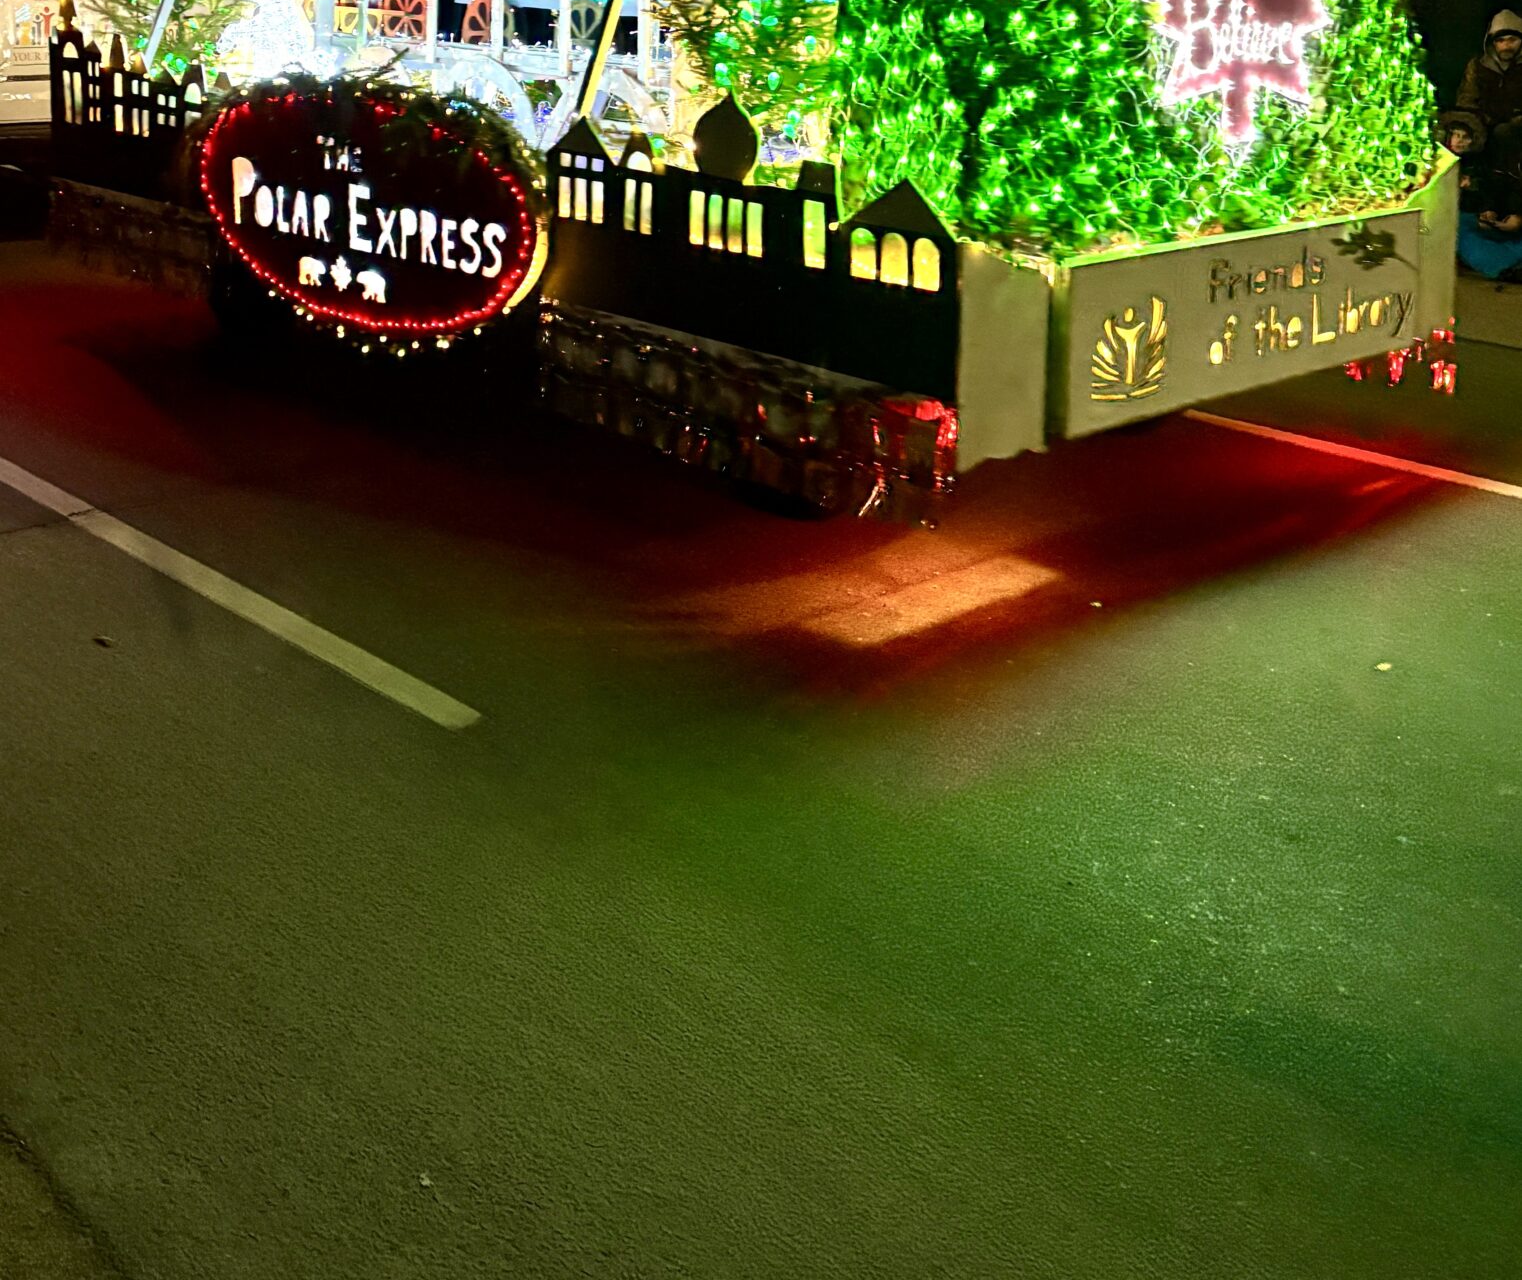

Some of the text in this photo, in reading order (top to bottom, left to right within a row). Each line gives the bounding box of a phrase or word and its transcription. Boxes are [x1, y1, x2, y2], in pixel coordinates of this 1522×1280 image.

[14, 52, 41, 62] YOUR
[232, 156, 507, 278] POLAR EXPRESS
[1208, 246, 1325, 303] Friends
[1209, 285, 1413, 365] of the Library
